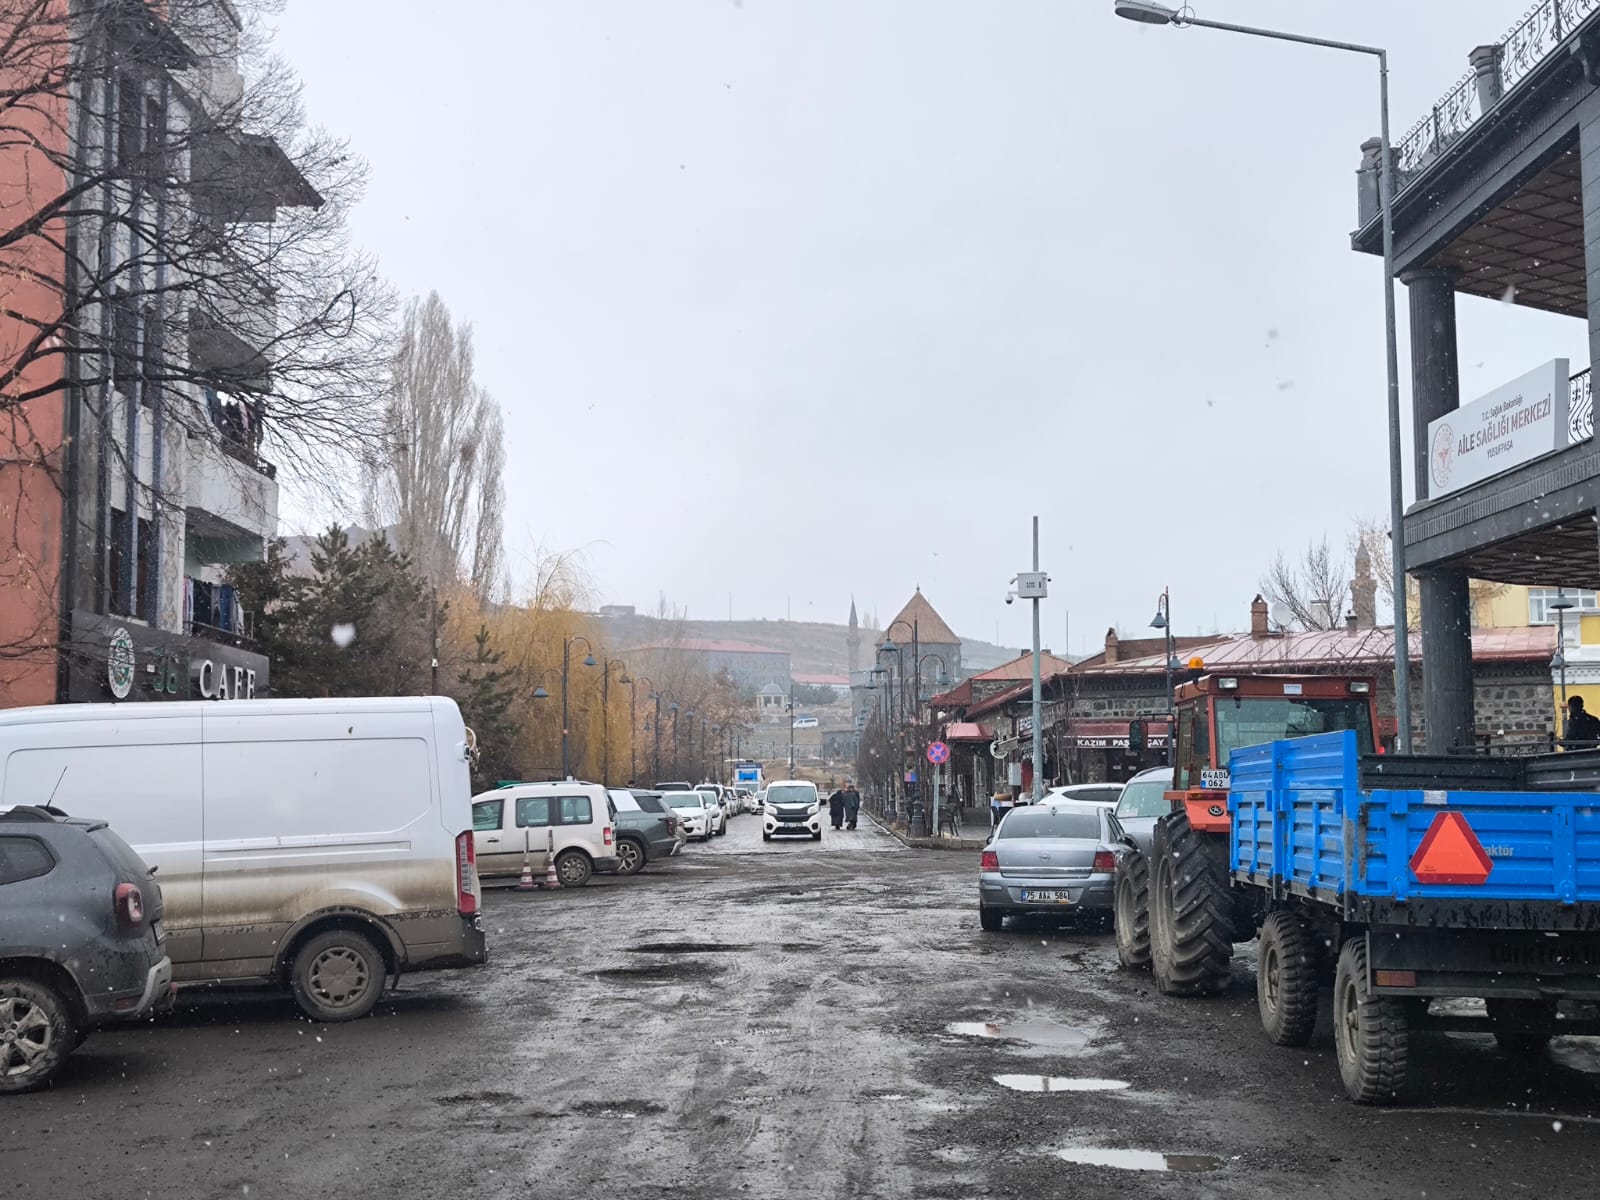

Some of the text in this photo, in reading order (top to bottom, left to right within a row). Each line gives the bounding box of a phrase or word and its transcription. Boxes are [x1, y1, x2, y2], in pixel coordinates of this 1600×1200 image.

[1457, 393, 1551, 456] AİLE SAĞLIĞI MERKEZİ
[1486, 440, 1514, 459] YUSUFPAŞA
[199, 659, 256, 699] CAFE
[1077, 739, 1106, 747] KAZIM
[1202, 771, 1213, 779] 64
[1208, 779, 1224, 787] 062
[1483, 843, 1514, 857] aktör
[1026, 891, 1035, 900] 75
